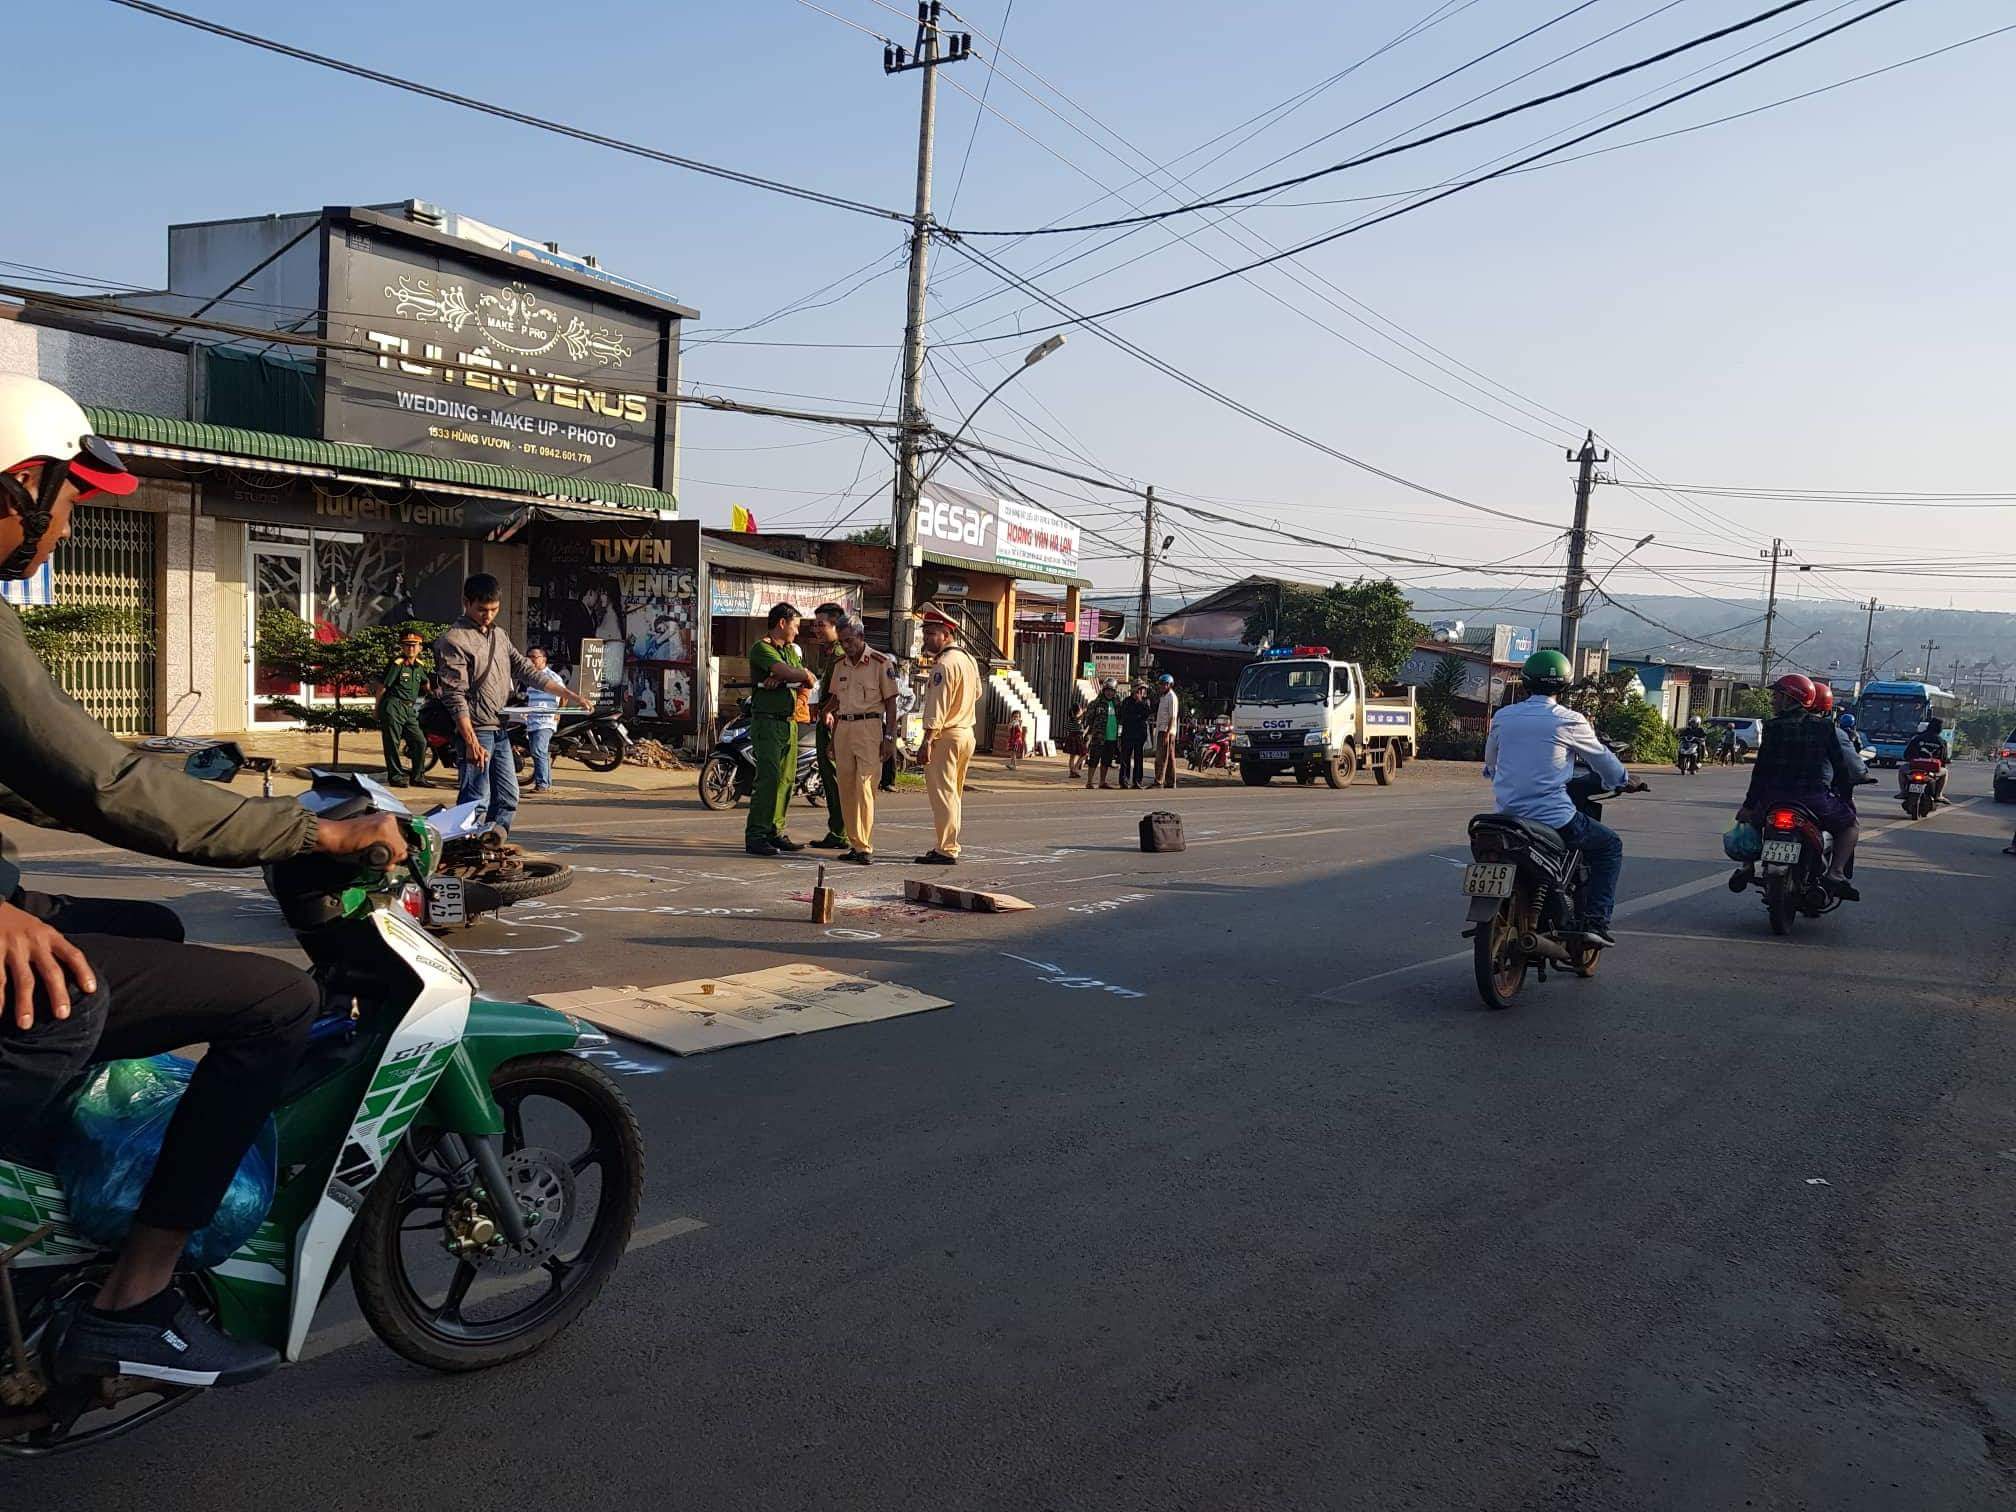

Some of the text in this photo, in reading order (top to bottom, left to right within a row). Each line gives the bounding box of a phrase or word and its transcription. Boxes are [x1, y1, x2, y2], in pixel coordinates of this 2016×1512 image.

[487, 316, 514, 332] MAKE
[529, 328, 547, 340] PRO
[527, 368, 648, 423] VENUS
[396, 391, 479, 422] WEDDING
[490, 410, 535, 432] MAKE
[538, 419, 558, 437] UP
[567, 425, 617, 448] PHOTO
[428, 426, 450, 439] 1533
[591, 532, 672, 565] TUYÊN
[616, 573, 693, 599] VENUS
[1262, 720, 1294, 729] CSGT
[447, 883, 462, 917] 1190
[1468, 879, 1503, 895] 8971
